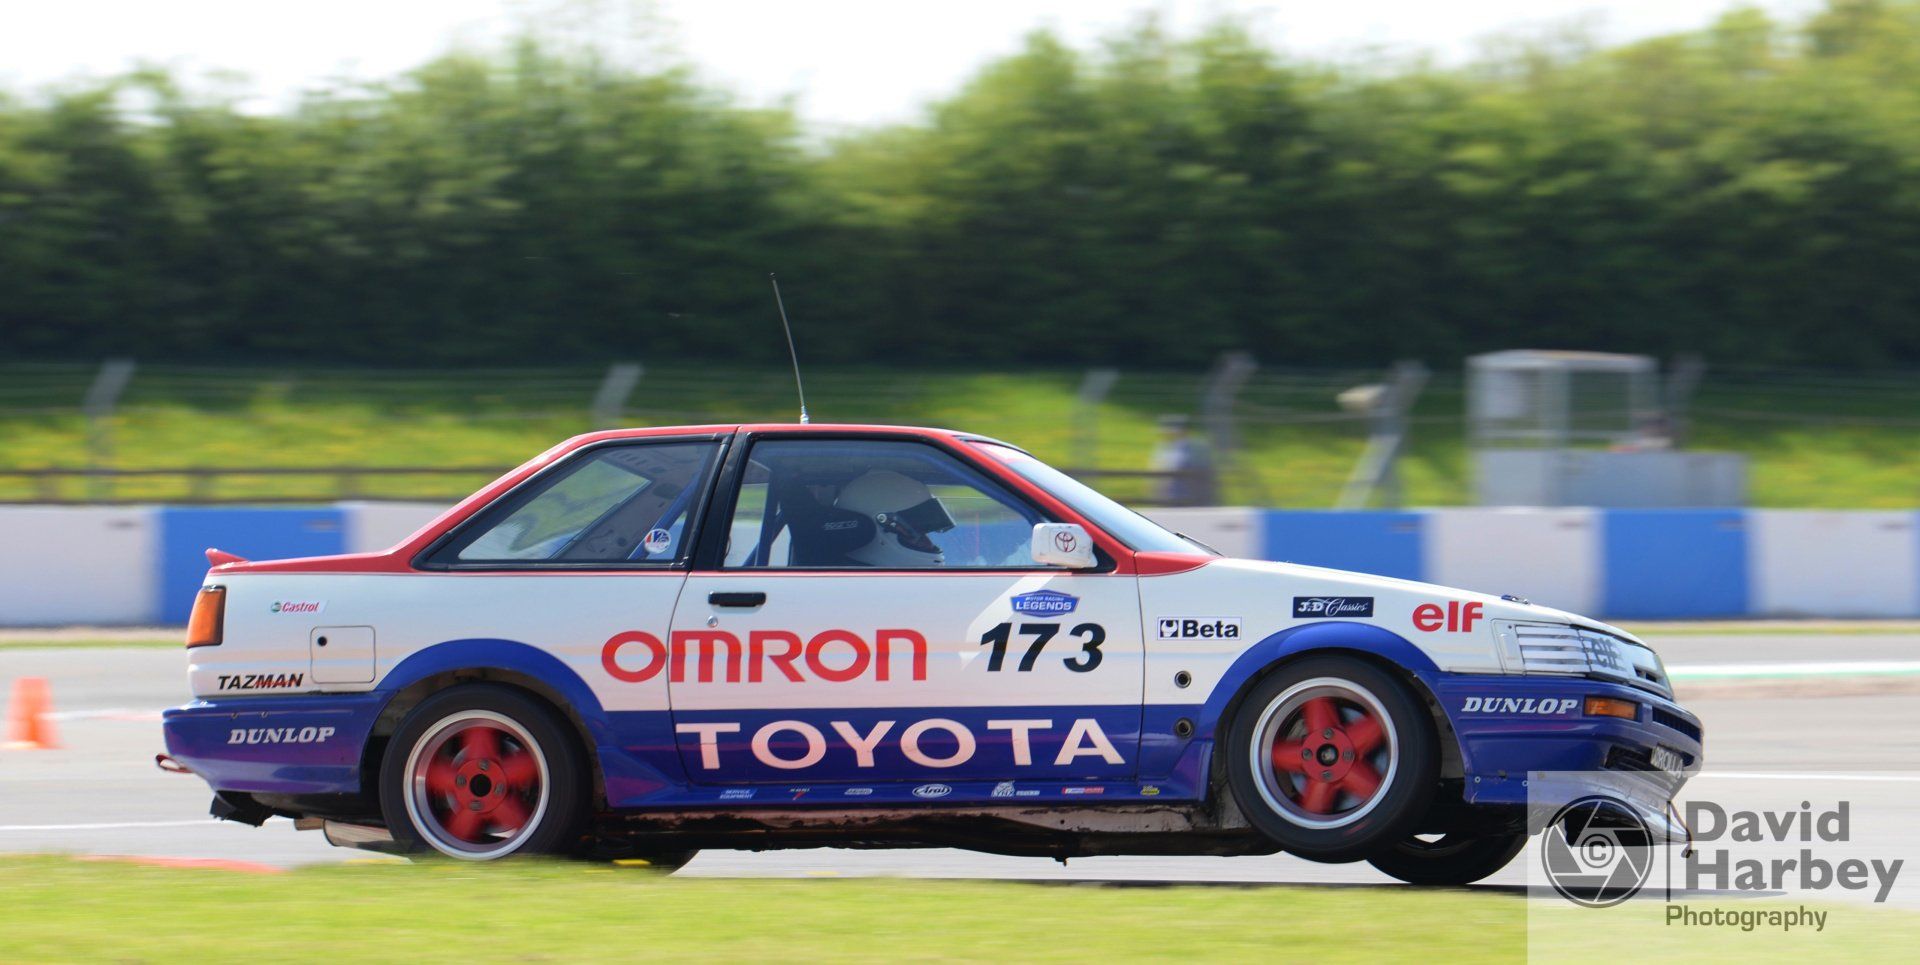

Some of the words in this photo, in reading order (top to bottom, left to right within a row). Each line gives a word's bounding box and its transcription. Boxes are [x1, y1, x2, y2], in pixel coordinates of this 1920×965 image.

[282, 601, 320, 613] Castrol
[1015, 601, 1073, 611] LEGENDS
[1324, 598, 1369, 617] Classics
[1412, 600, 1483, 632] elf
[1182, 619, 1239, 638] Beta
[977, 622, 1106, 673] 173
[218, 673, 304, 690] TAZMAN
[1461, 696, 1578, 714] DUNLOP
[227, 726, 335, 745] DUNLOP
[675, 718, 1126, 770] TOYOTA
